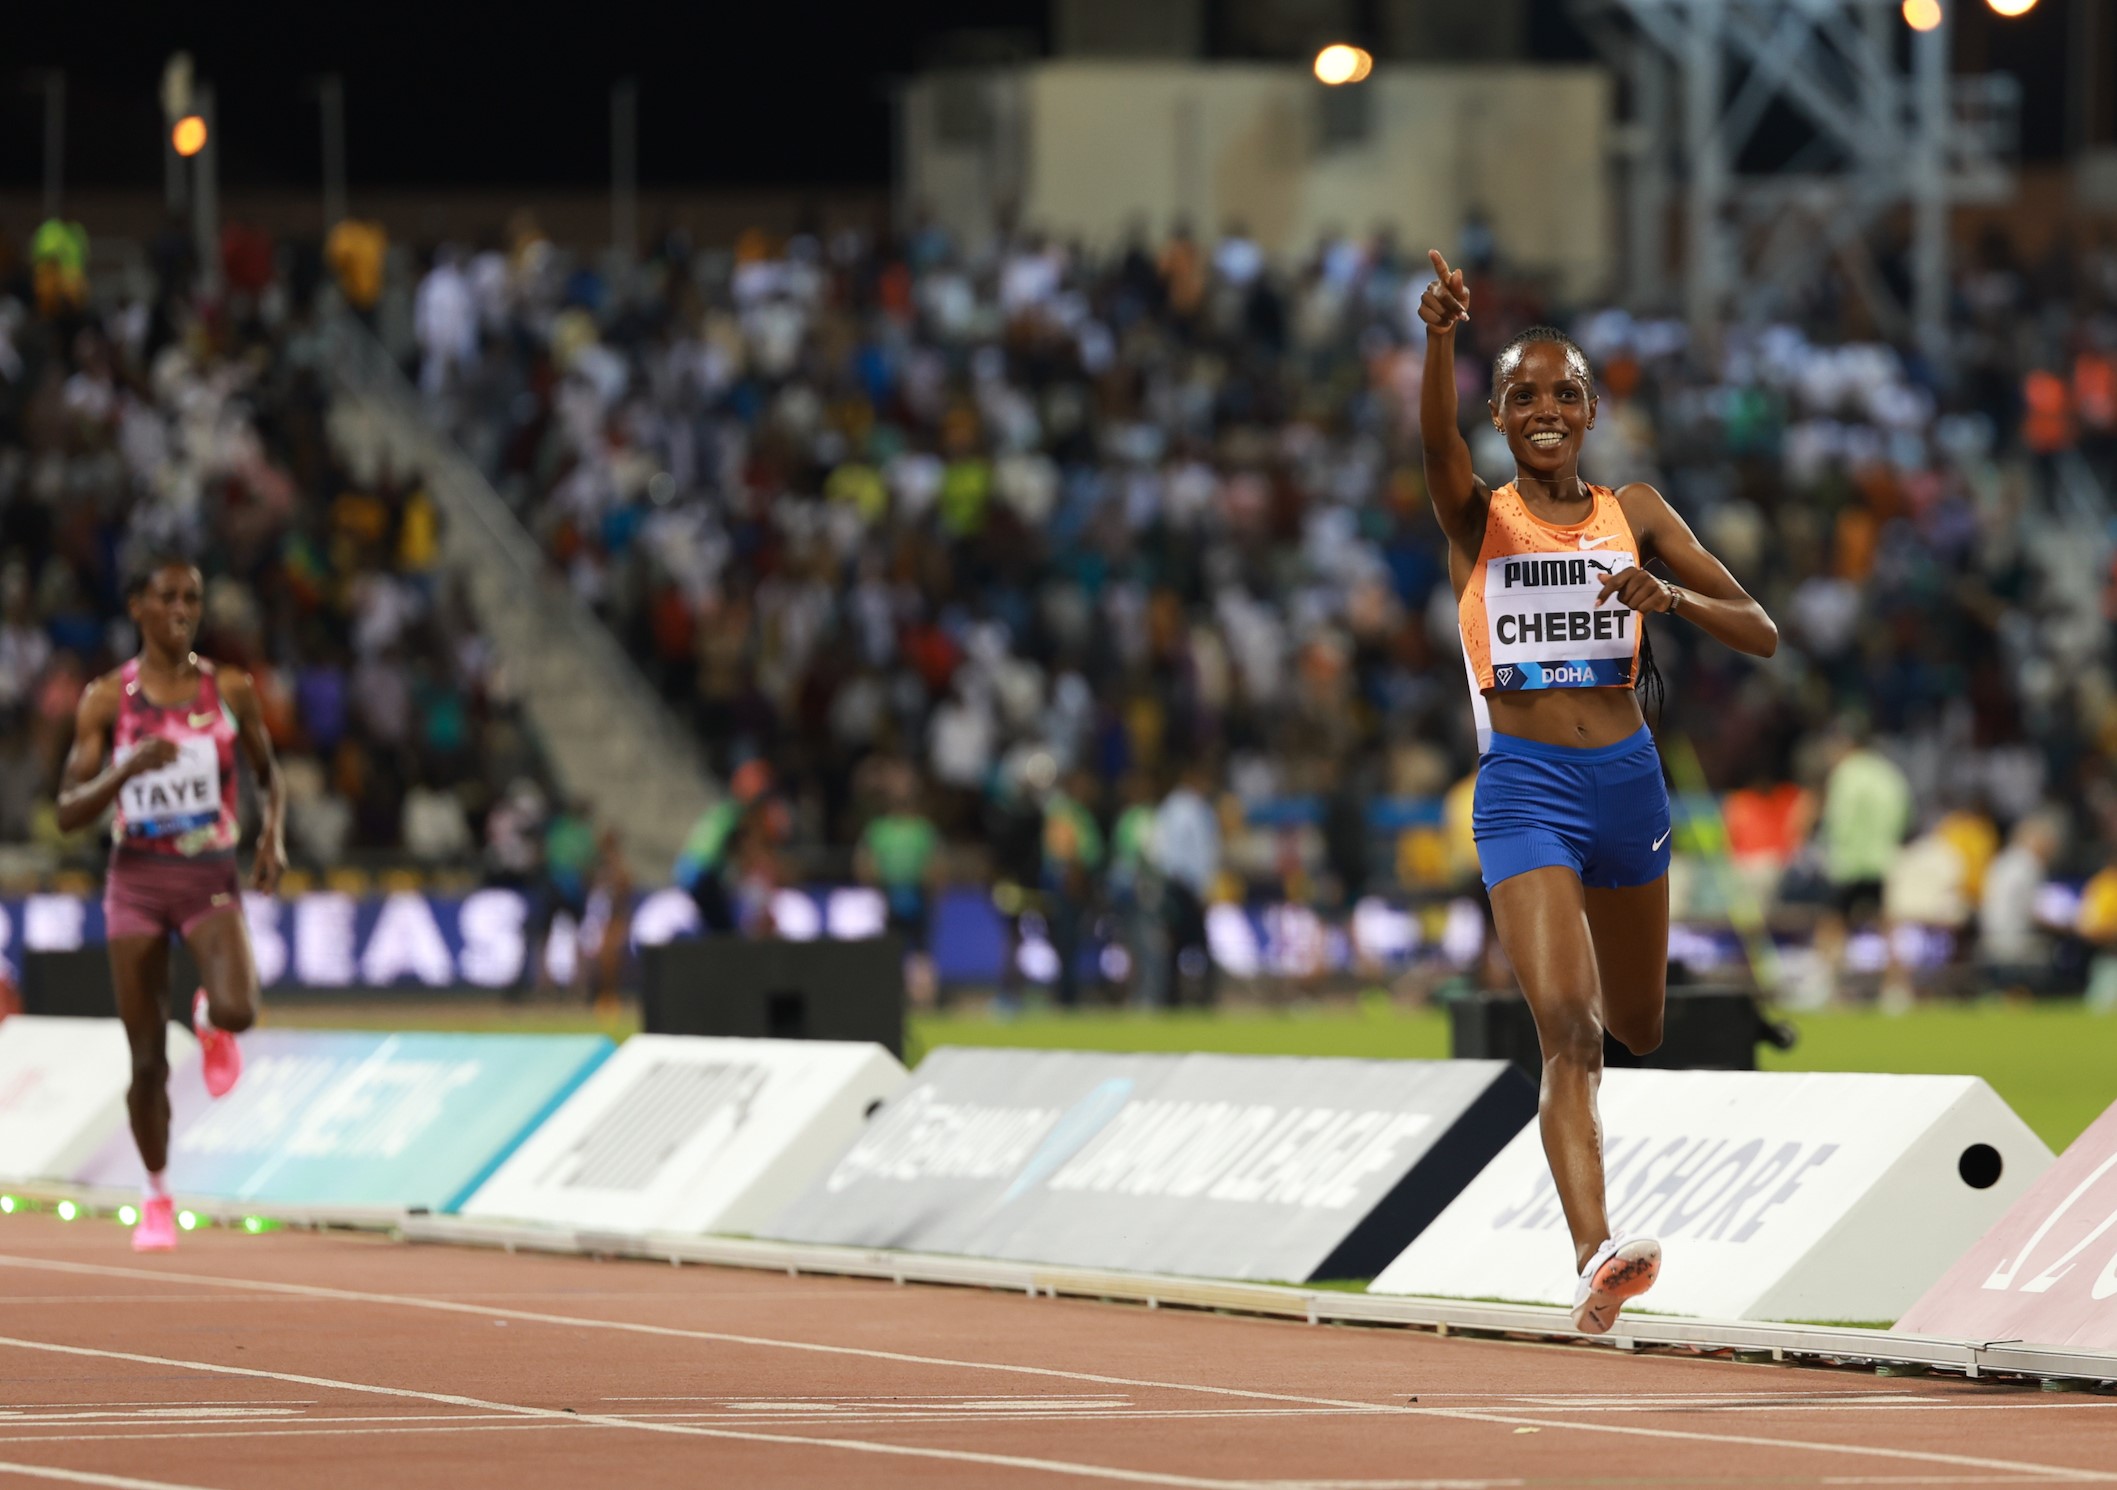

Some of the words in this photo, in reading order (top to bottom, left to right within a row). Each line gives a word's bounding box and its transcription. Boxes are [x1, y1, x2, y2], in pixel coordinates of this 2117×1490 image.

[1505, 558, 1587, 588] PUMA
[1496, 609, 1631, 645] CHEBET
[1541, 667, 1595, 684] DOHA
[132, 779, 208, 806] TAYE
